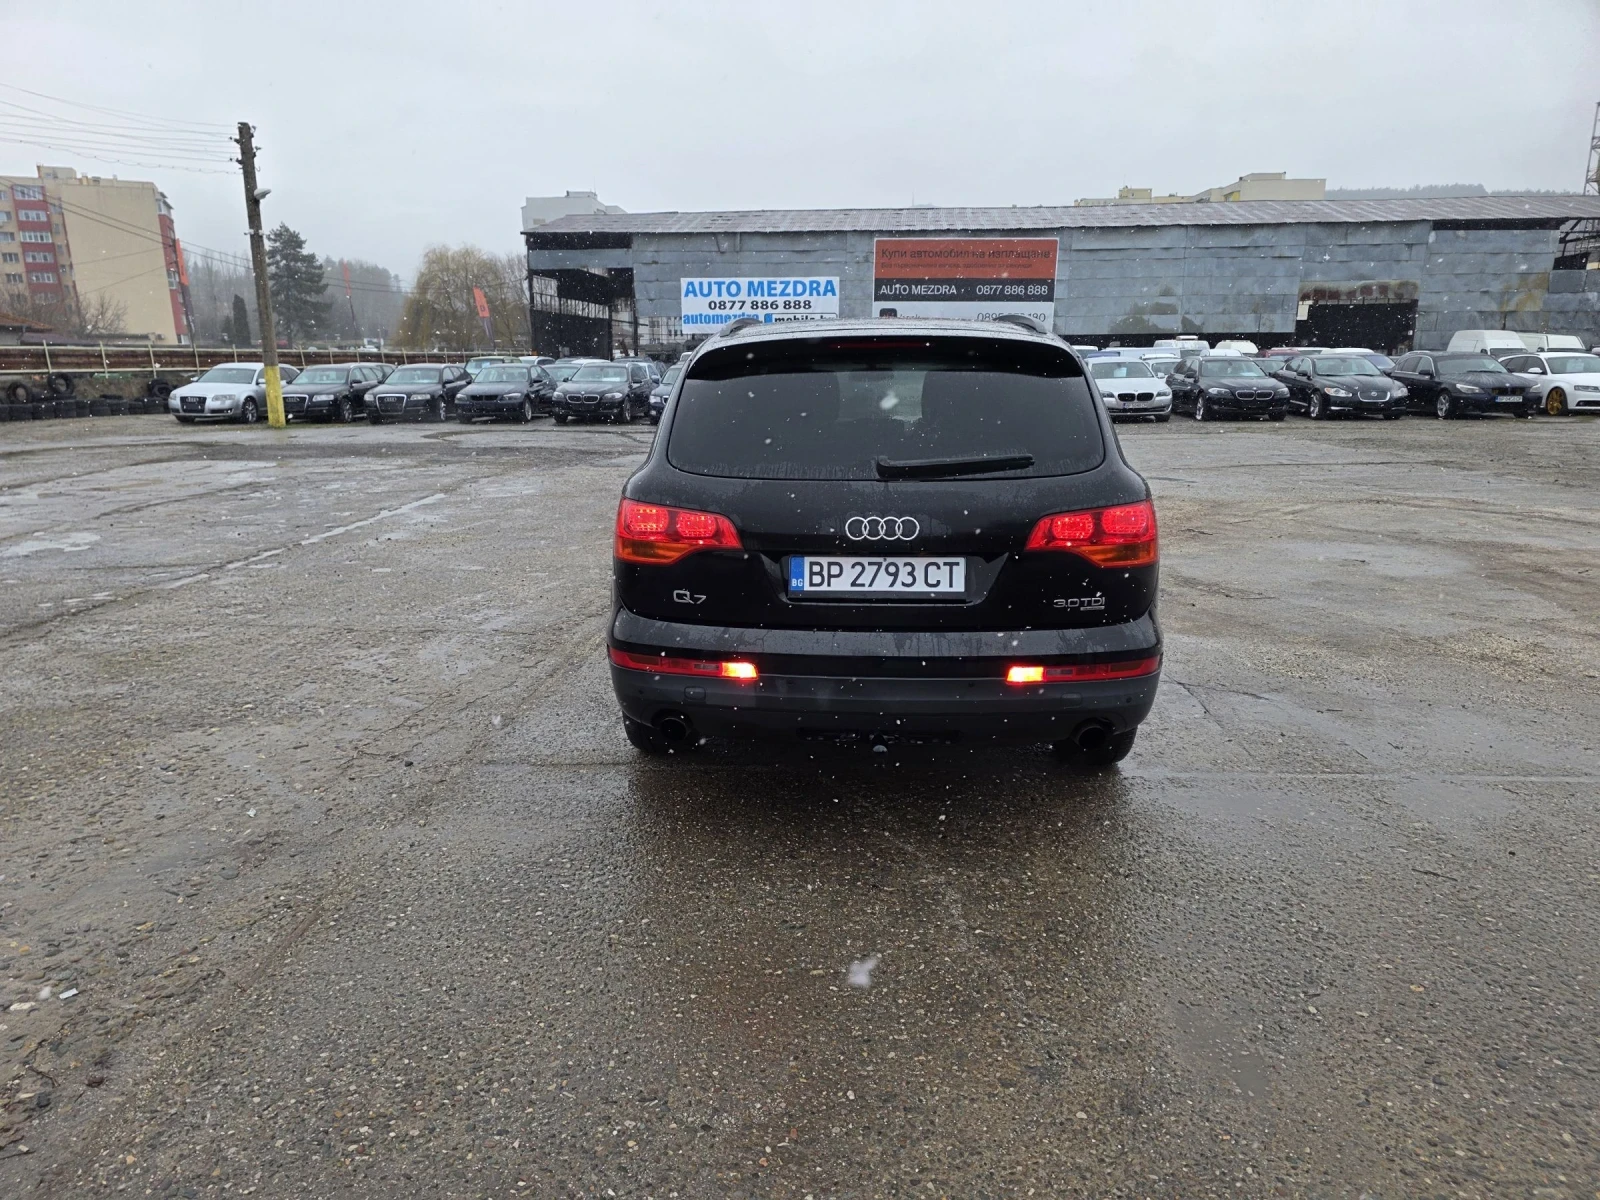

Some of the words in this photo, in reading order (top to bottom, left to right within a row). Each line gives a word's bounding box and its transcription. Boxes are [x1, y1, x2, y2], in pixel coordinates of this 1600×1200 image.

[881, 248, 907, 260] Купи
[910, 249, 969, 258] автомобил
[988, 250, 1050, 259] изплащане
[684, 281, 741, 297] AUTO
[747, 280, 836, 297] MEZDRA
[880, 284, 909, 294] AUTO
[911, 285, 957, 294] MEZDRA
[976, 285, 1002, 295] 0877
[1004, 285, 1025, 295] 886
[1027, 285, 1048, 295] 888
[708, 300, 746, 310] 0877
[750, 300, 779, 310] 886
[782, 300, 812, 310] 888
[808, 561, 843, 587] BP
[850, 561, 917, 588] 2793
[924, 561, 960, 588] CT
[792, 579, 803, 587] BG
[673, 590, 707, 604] Q7
